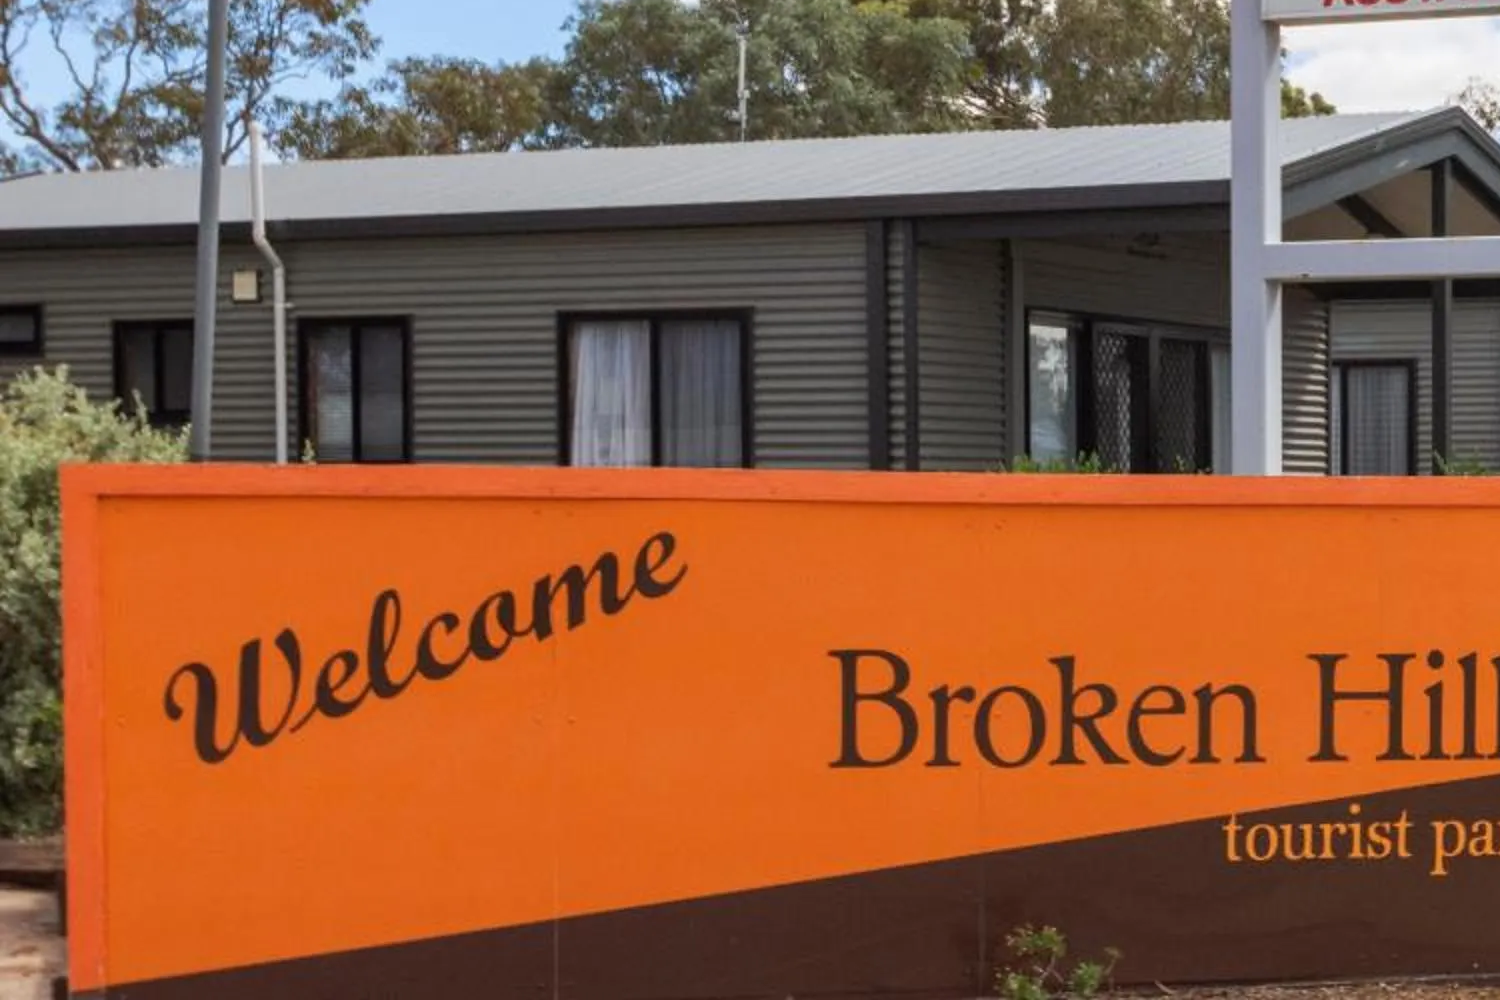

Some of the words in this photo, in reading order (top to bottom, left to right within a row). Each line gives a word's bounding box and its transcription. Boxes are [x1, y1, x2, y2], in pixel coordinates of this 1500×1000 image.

[164, 531, 688, 765] Welcome
[828, 649, 1267, 768] Broken
[1223, 803, 1412, 863] tourist
